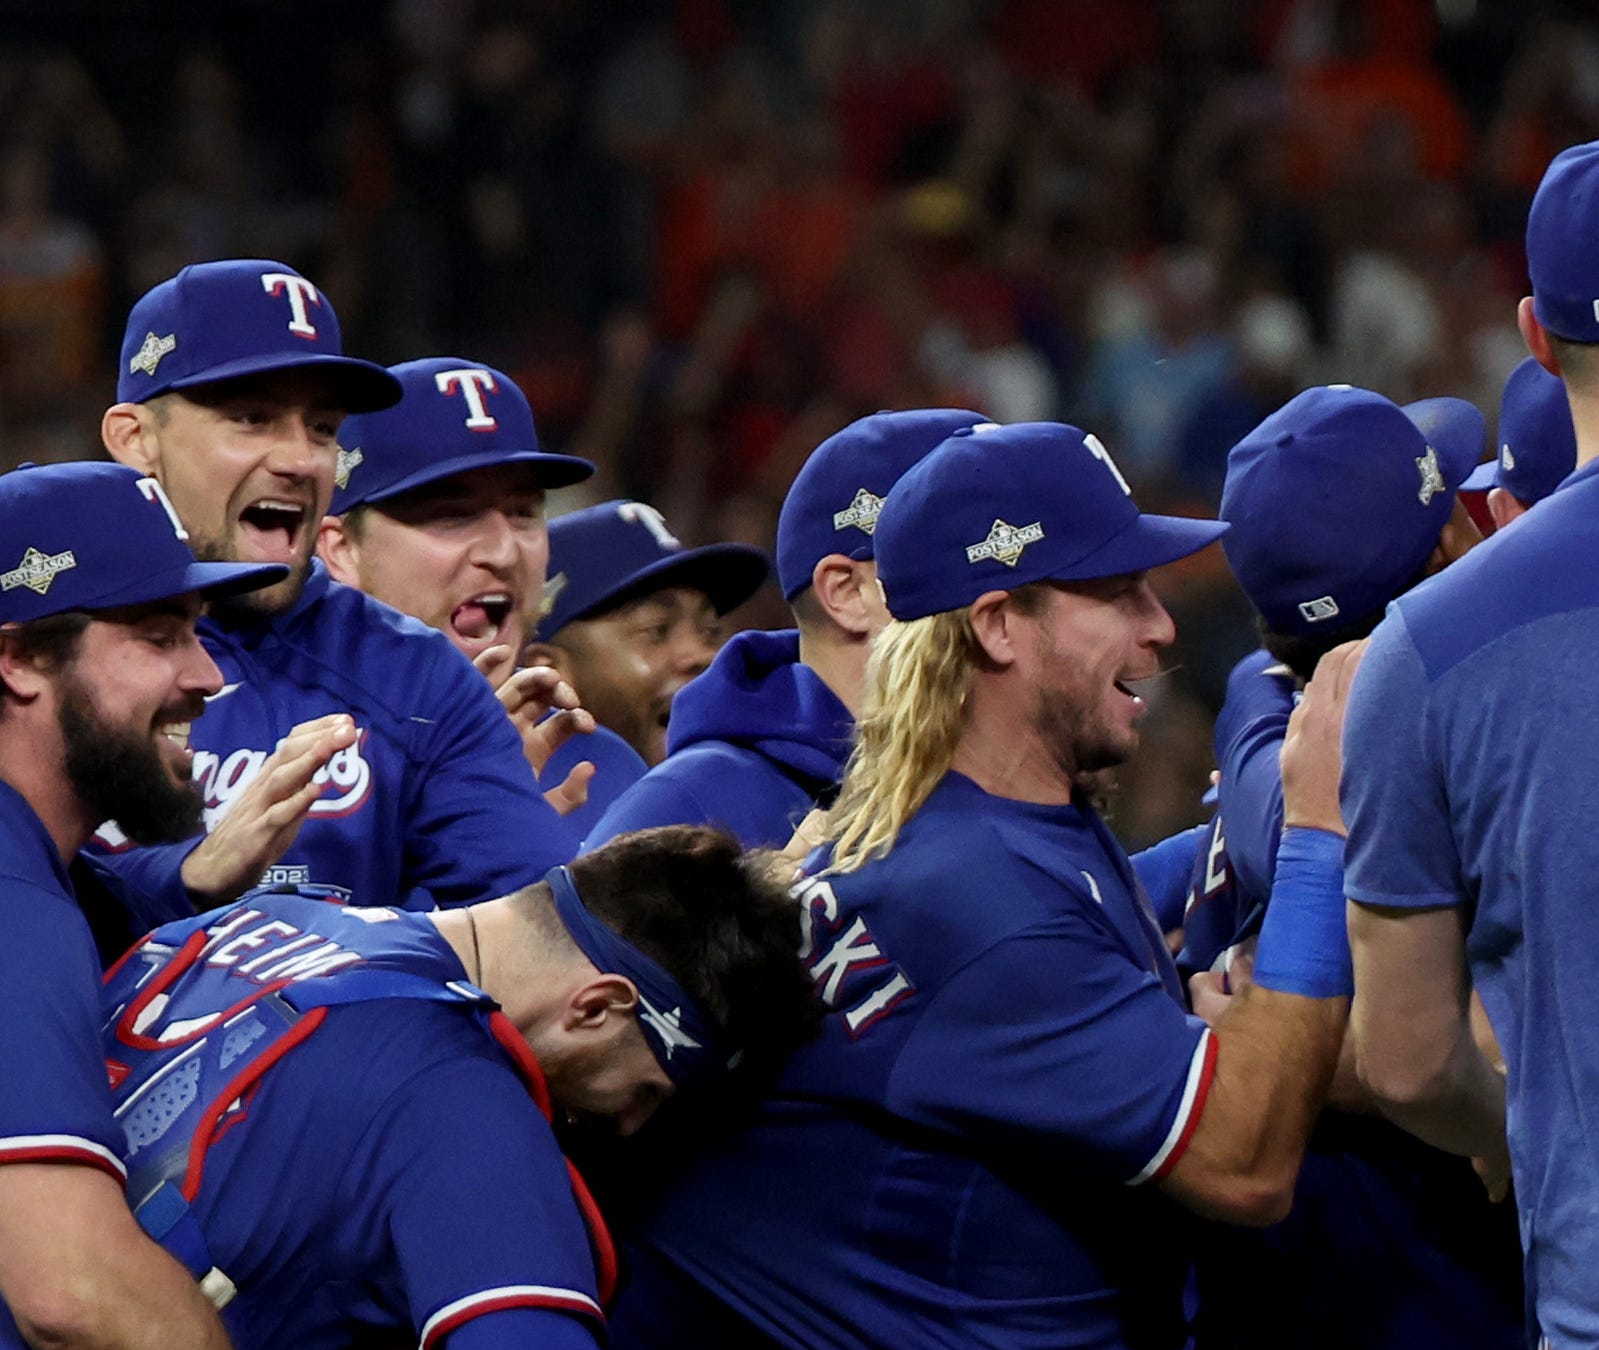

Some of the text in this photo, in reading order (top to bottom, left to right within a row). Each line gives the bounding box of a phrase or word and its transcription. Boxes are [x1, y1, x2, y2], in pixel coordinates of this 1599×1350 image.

[261, 273, 321, 341] T
[434, 369, 499, 432] T
[965, 521, 1045, 564] POSTSEASON
